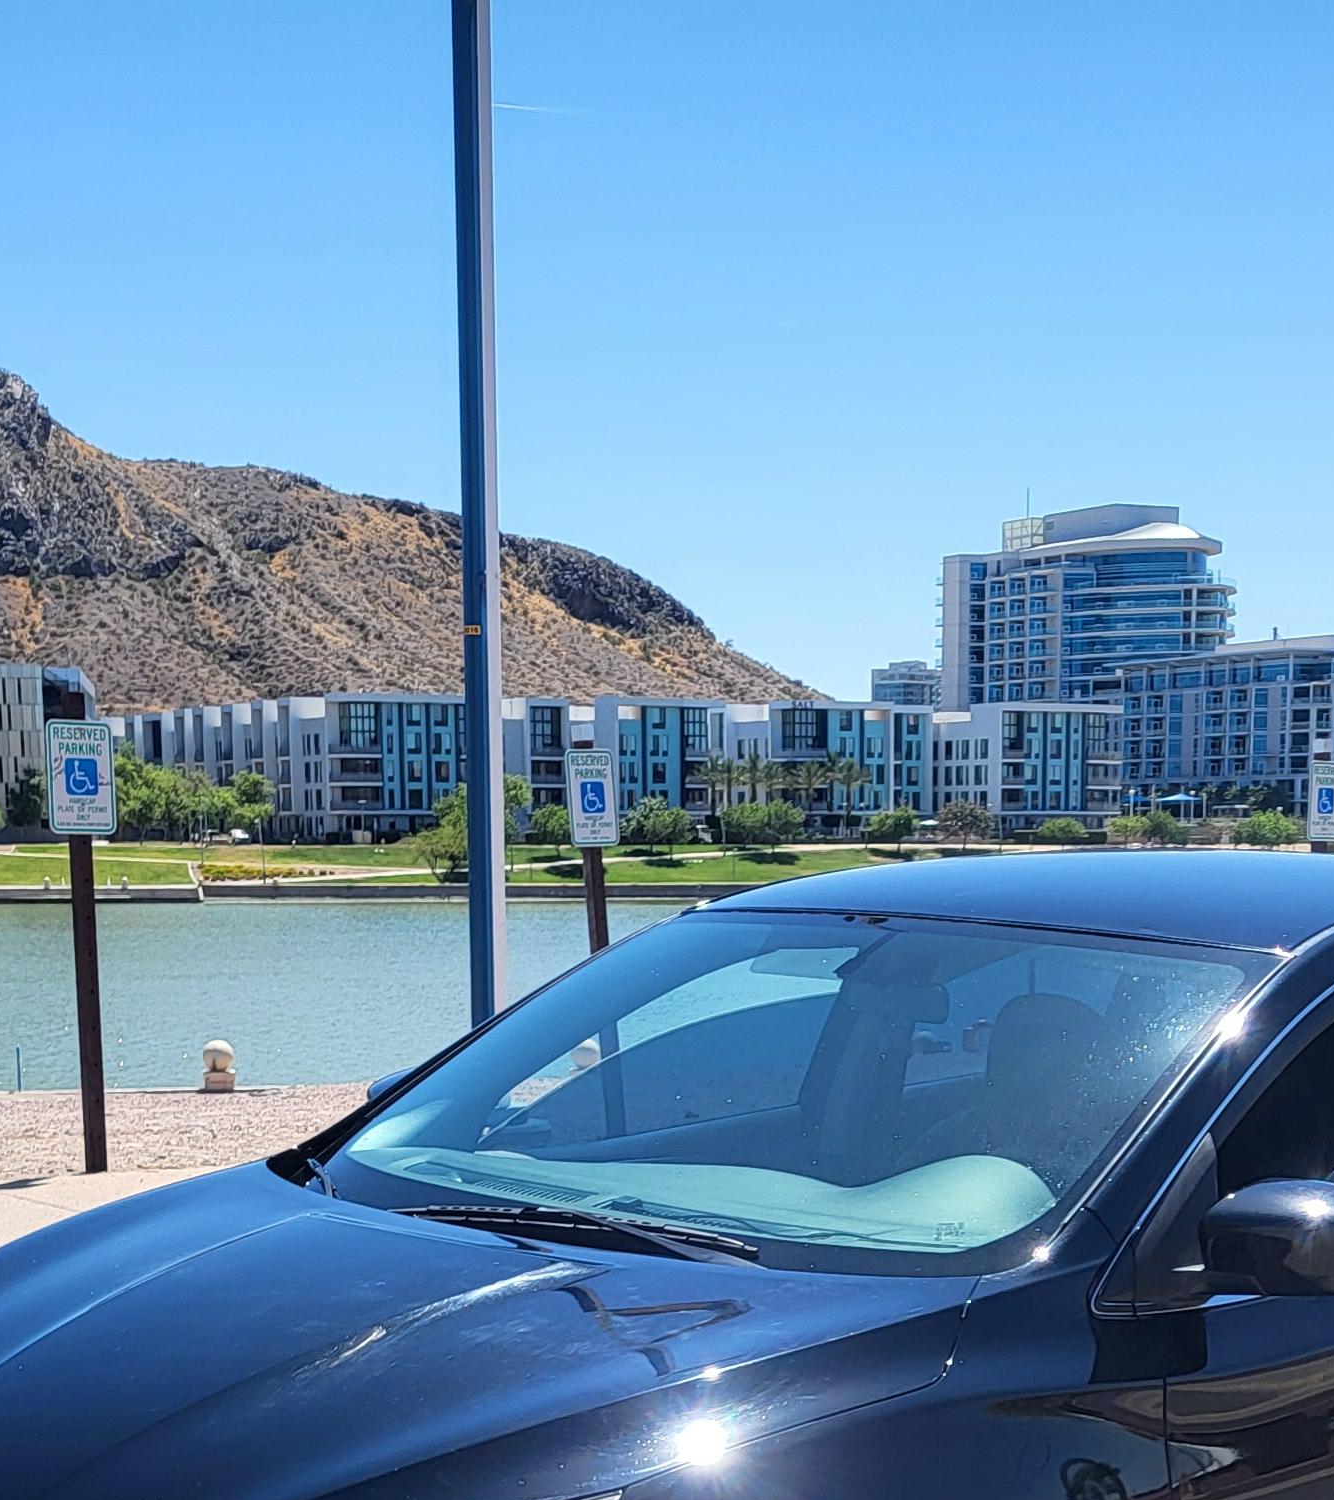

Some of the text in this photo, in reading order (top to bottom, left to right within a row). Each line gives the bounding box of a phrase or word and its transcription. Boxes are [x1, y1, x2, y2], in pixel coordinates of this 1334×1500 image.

[52, 726, 106, 741] RESERVED
[58, 742, 103, 756] PARKING
[570, 754, 609, 767] RESERVED
[574, 768, 608, 779] PARKING
[57, 804, 75, 813] PLATE
